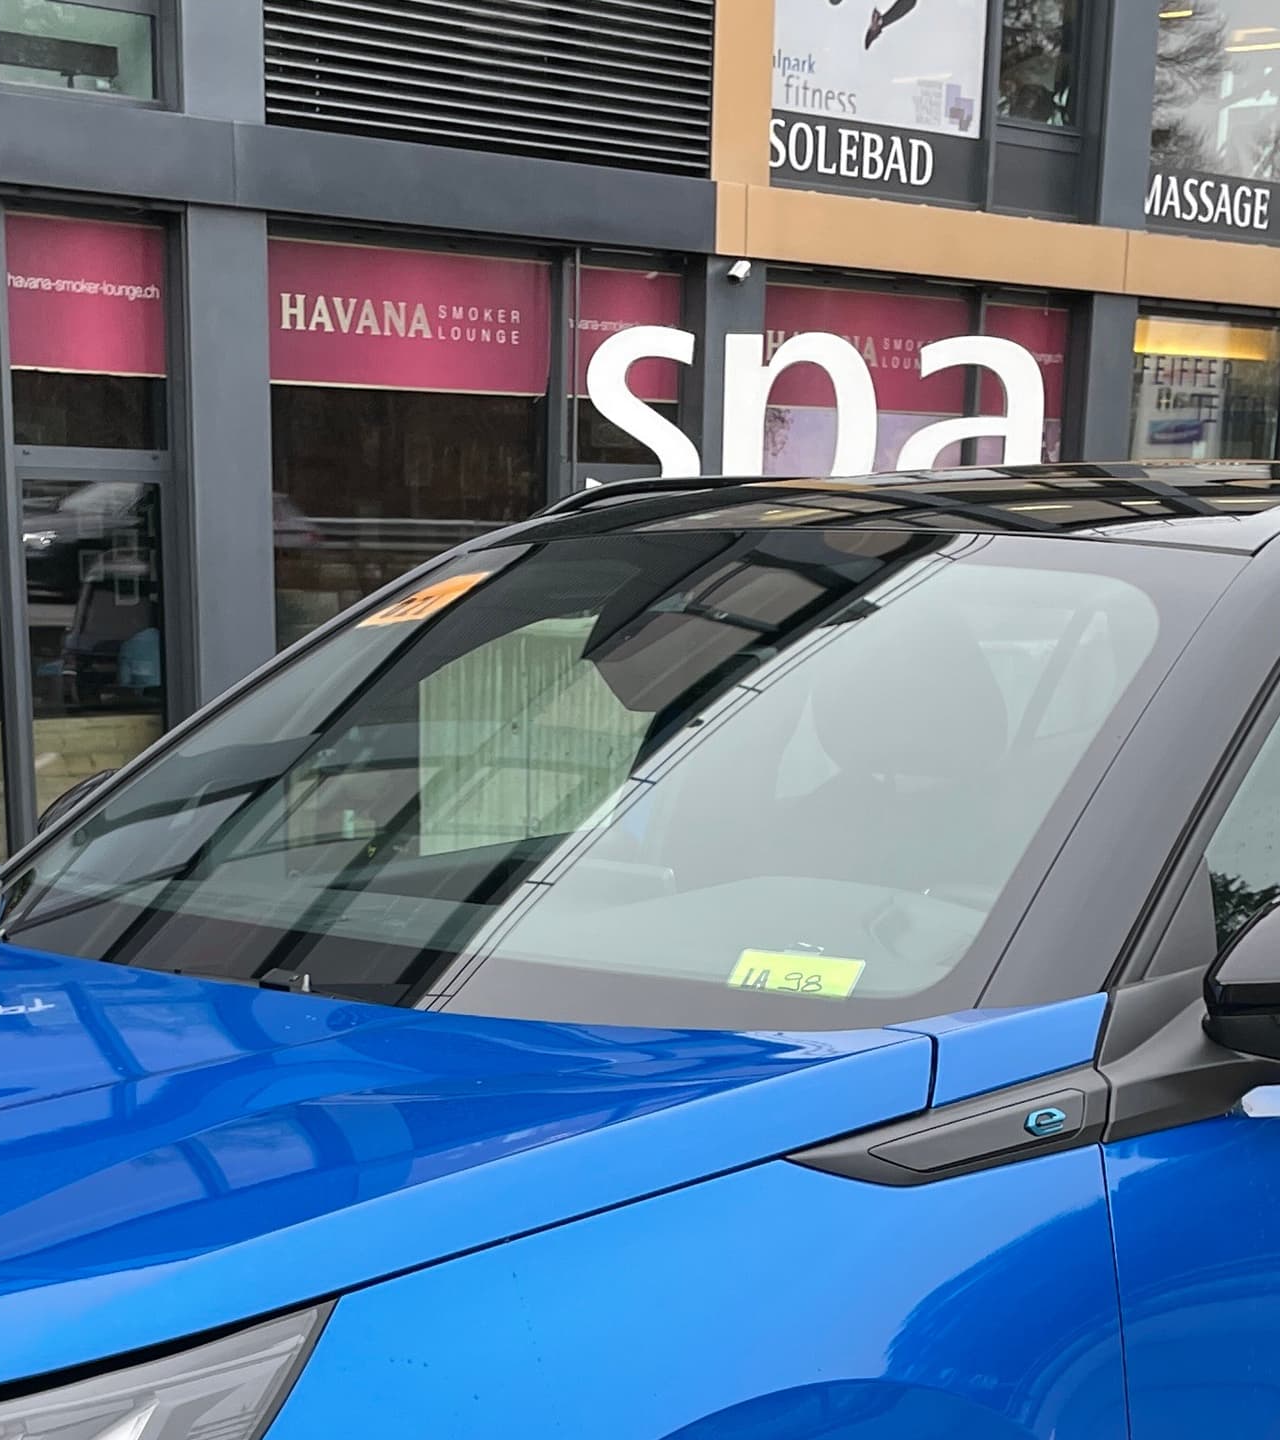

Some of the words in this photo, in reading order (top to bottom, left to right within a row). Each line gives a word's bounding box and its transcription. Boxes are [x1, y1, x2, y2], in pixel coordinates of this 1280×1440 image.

[784, 74, 857, 115] fitness
[769, 118, 934, 187] SOLEBAD
[7, 271, 161, 301] havana-smoker-lounge.ch
[280, 292, 434, 340] HAVANA
[438, 304, 521, 324] SMOKER
[438, 325, 521, 346] LOUNGE
